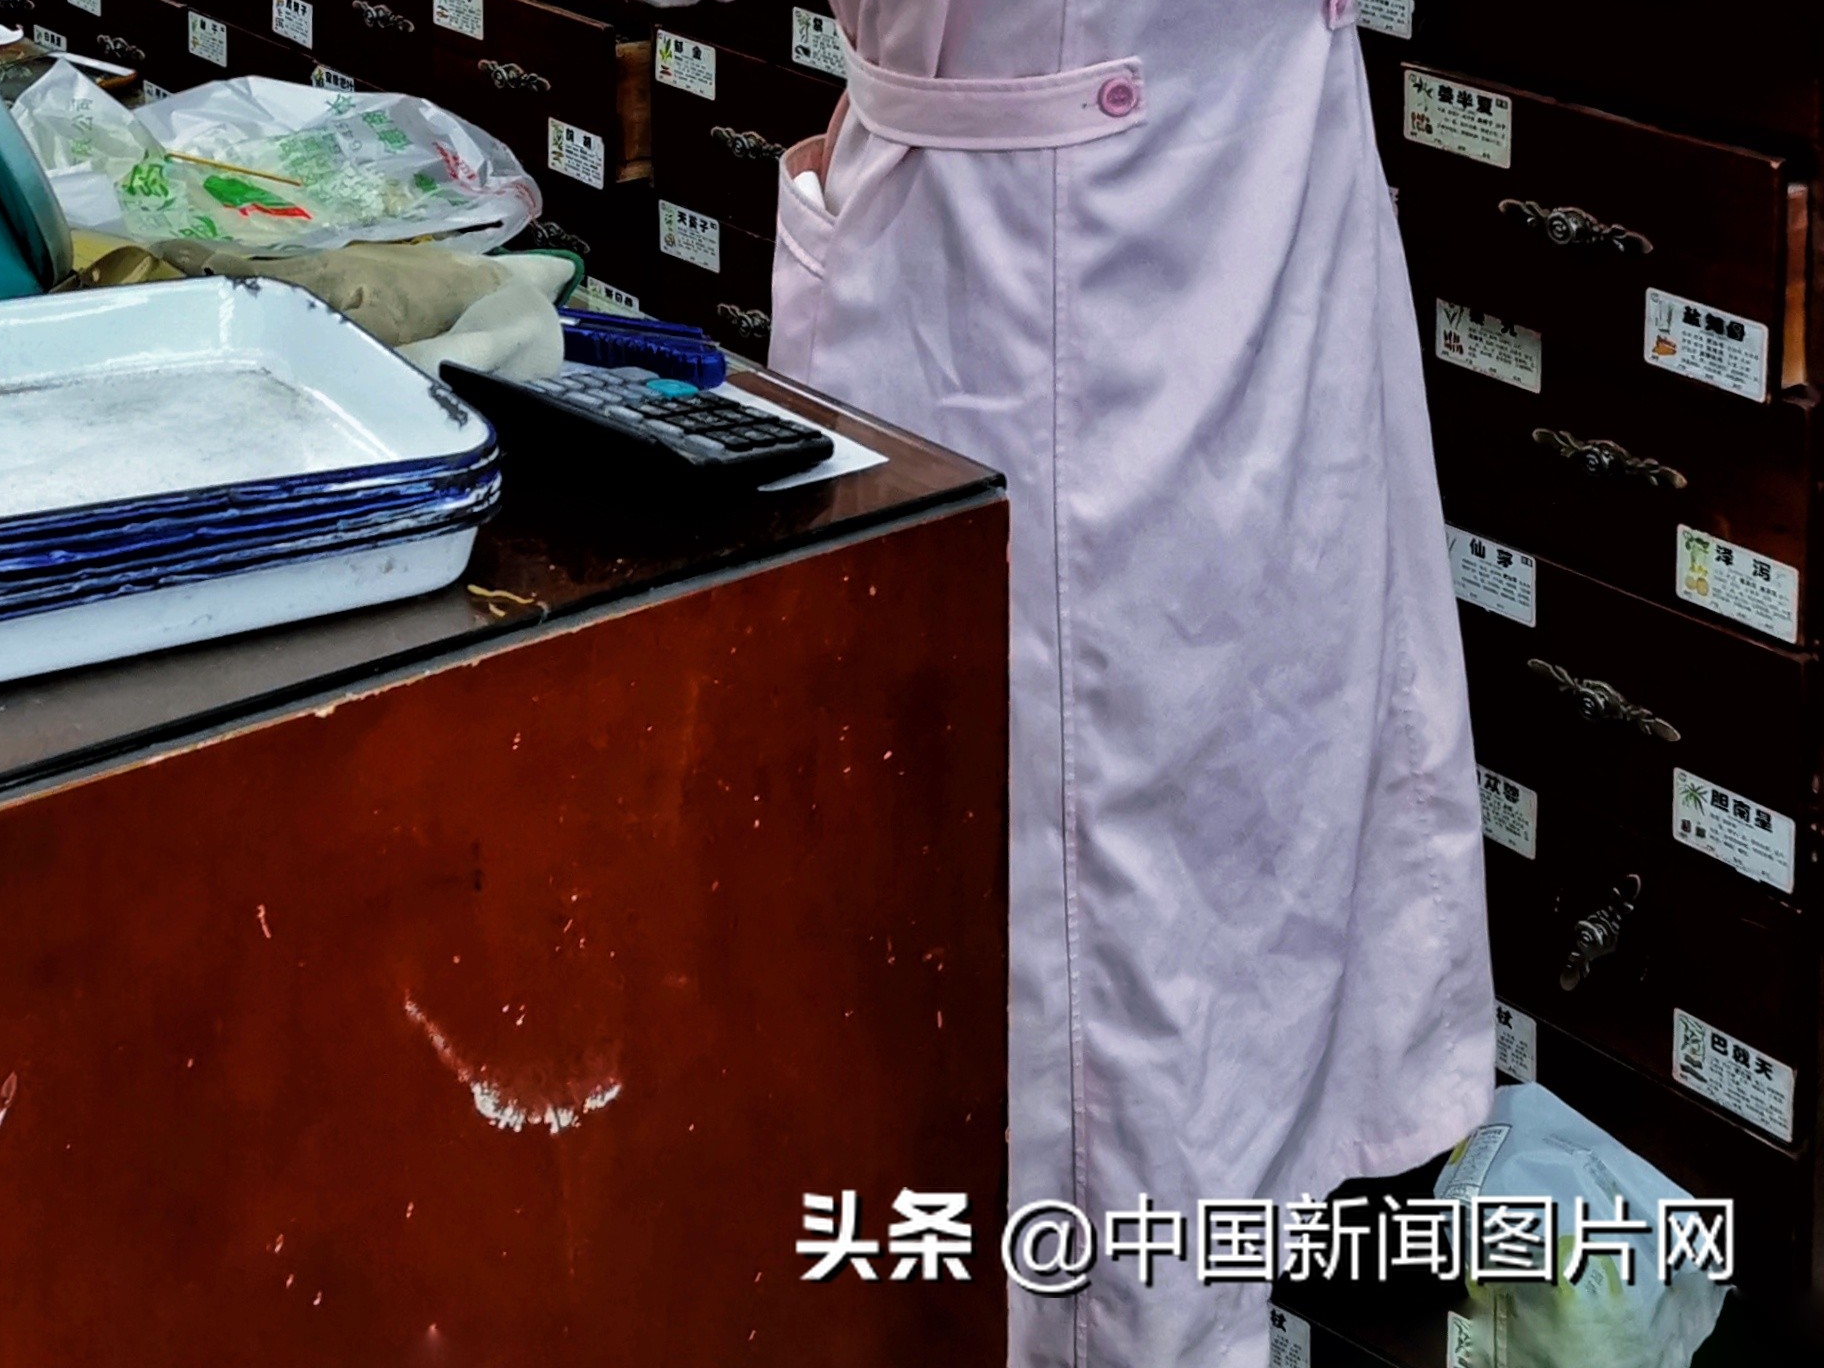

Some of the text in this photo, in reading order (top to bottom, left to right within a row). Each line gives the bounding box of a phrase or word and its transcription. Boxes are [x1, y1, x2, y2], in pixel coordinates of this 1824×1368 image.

[673, 39, 702, 61] 郁金
[1469, 538, 1513, 568] 仙茅
[1715, 544, 1771, 582] 泽泻
[1477, 767, 1520, 804] 苁蓉
[1710, 788, 1773, 830] 胆南星
[1496, 1005, 1512, 1030] 杖
[1711, 1032, 1775, 1078] 巴戟天
[1272, 1312, 1287, 1335] 杖
